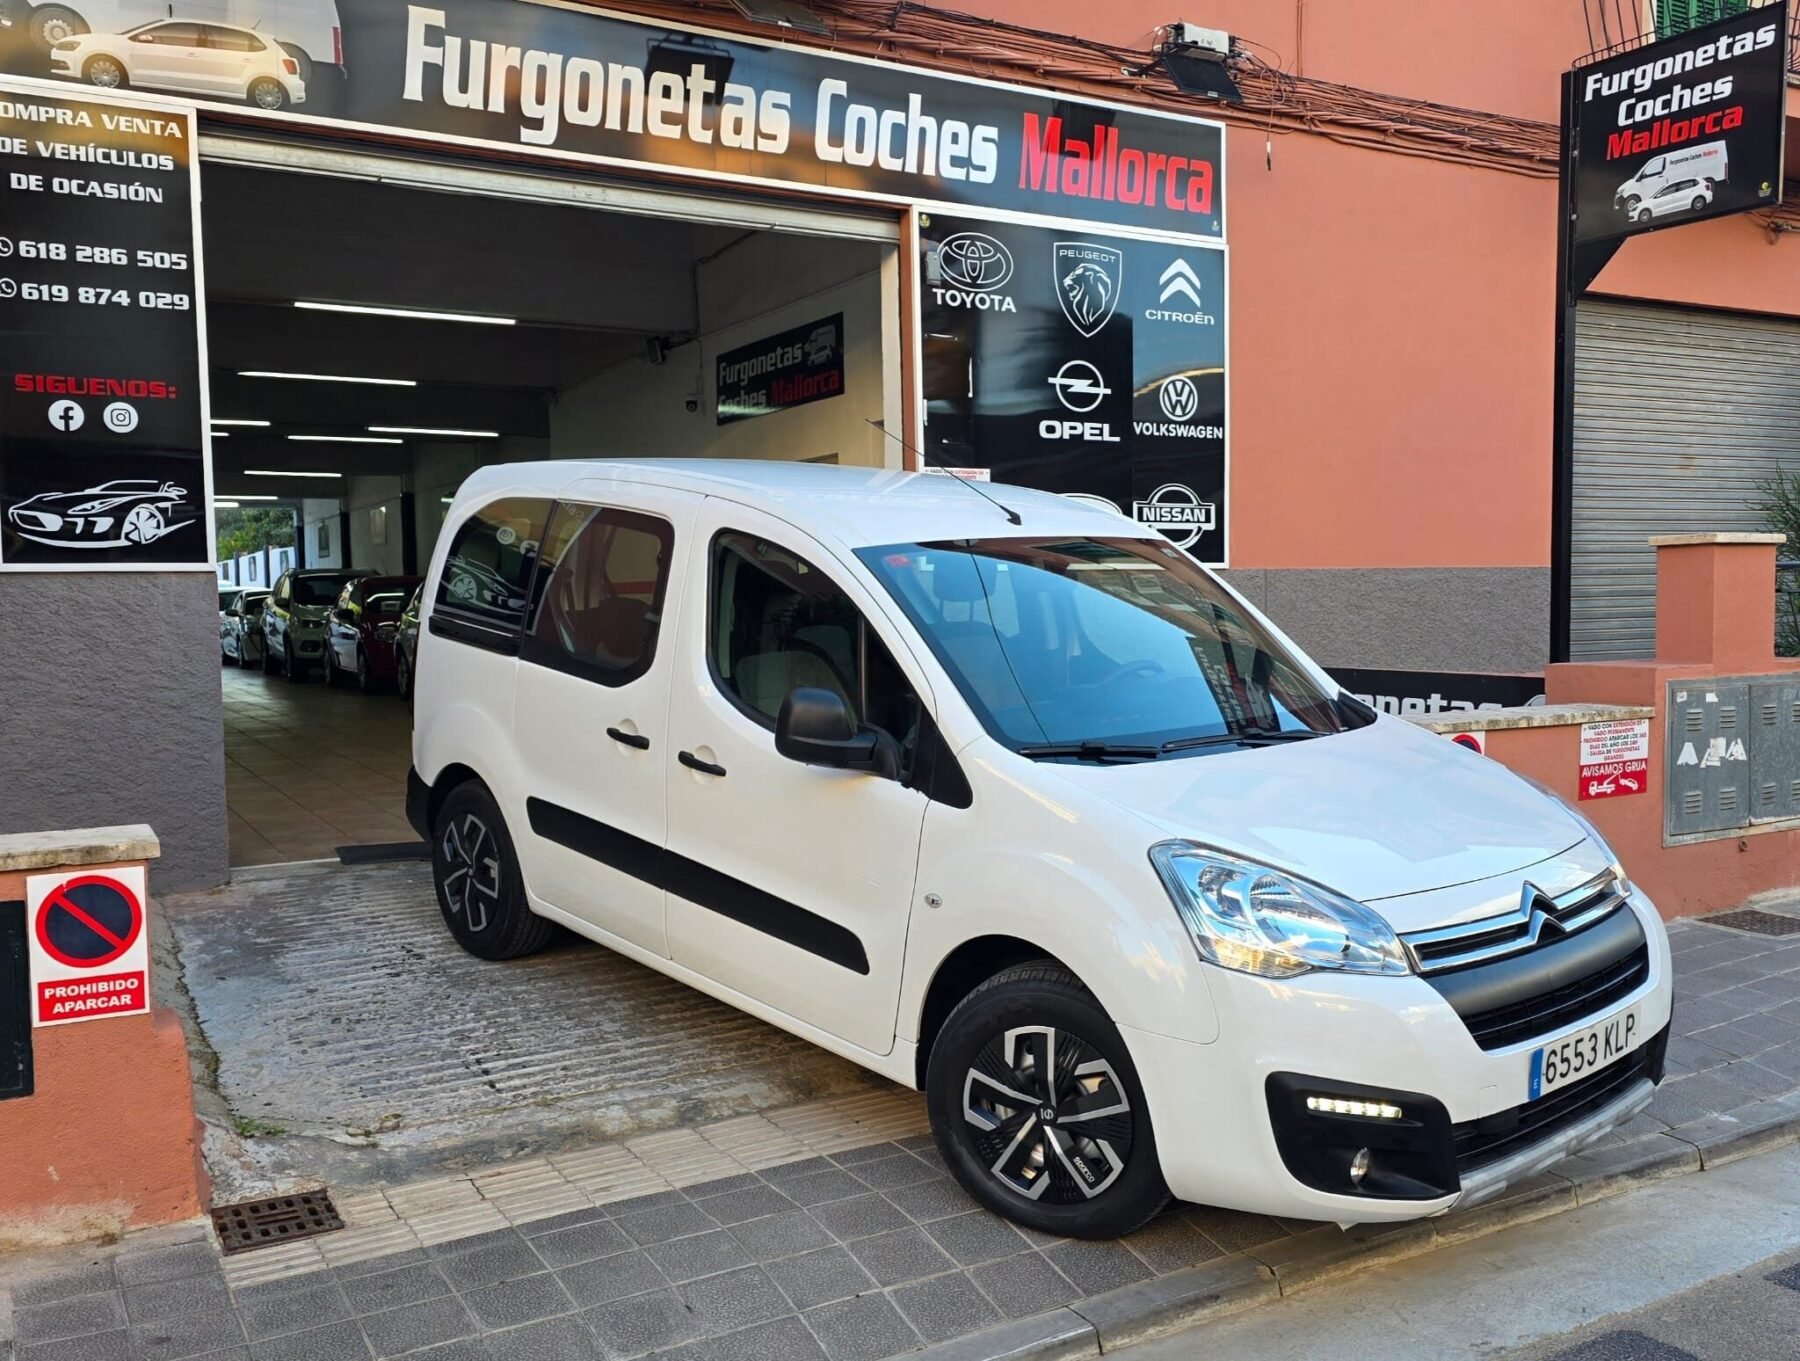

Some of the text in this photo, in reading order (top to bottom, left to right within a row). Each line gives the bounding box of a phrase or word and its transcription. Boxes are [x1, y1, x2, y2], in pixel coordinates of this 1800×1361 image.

[1584, 24, 1776, 102] Furgonetas
[403, 4, 1213, 214] Furgonetas Coches Mallorca
[1618, 75, 1734, 127] Coches
[101, 113, 183, 139] VENTA
[1606, 106, 1744, 160] Mallorca
[0, 136, 174, 171] DE VEHÍCULOS
[10, 173, 163, 203] DE OCASIÓN
[18, 240, 188, 270] 618 286 505
[1059, 249, 1116, 263] PEUGEOT
[21, 282, 190, 311] 619 874 029
[932, 288, 1017, 313] TOYOTA
[720, 343, 803, 386] Furgonetas
[15, 373, 177, 399] SIGUENOS:
[771, 369, 840, 405] Mallorca
[1039, 420, 1121, 442] OPEL
[1133, 421, 1223, 439] VOLKSWAGEN
[1142, 507, 1206, 522] NISSAN
[1581, 760, 1647, 778] AVISAMOS GRUA
[44, 978, 139, 1000] PROHIBIDO
[52, 994, 132, 1014] APARCAR
[1545, 1032, 1598, 1084] 6553
[1604, 1013, 1635, 1060] KLP
